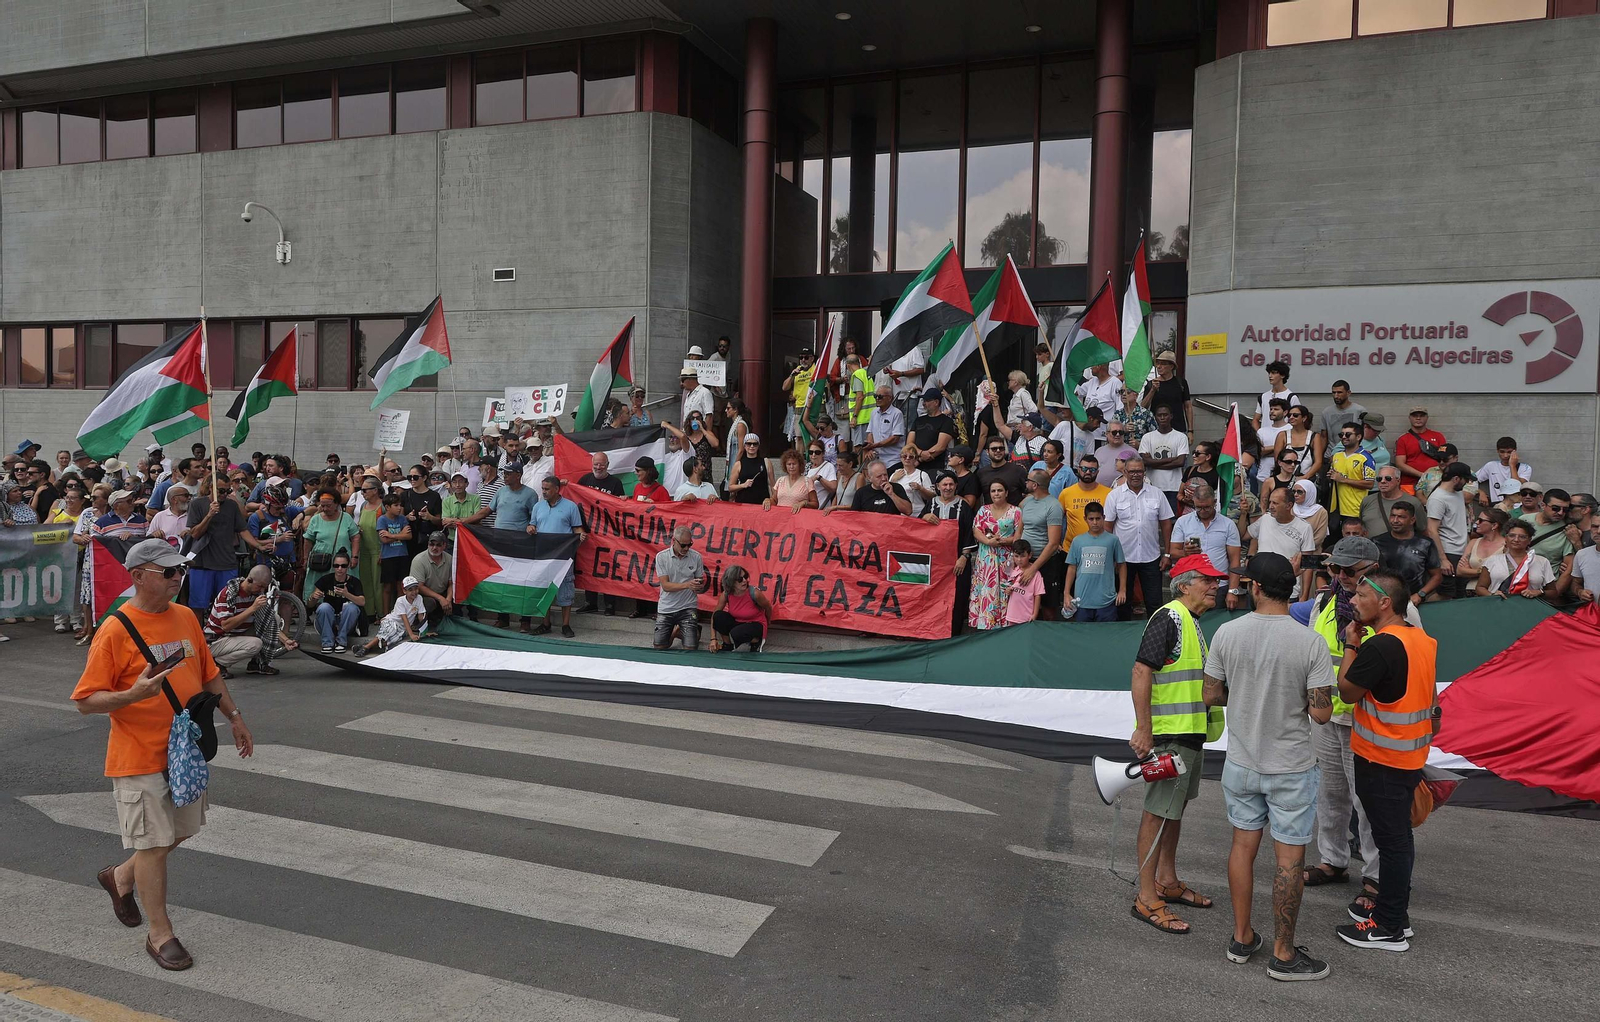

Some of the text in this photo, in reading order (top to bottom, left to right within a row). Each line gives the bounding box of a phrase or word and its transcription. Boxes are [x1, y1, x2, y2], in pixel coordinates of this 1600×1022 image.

[1240, 321, 1469, 342] Autoridad Portuaria
[1240, 346, 1514, 368] de la Bahía de Algeciras
[578, 500, 883, 573] NINGÚN PUERTO PARA
[1, 564, 62, 608] DIO
[758, 572, 790, 605] EN
[803, 574, 903, 619] GAZA
